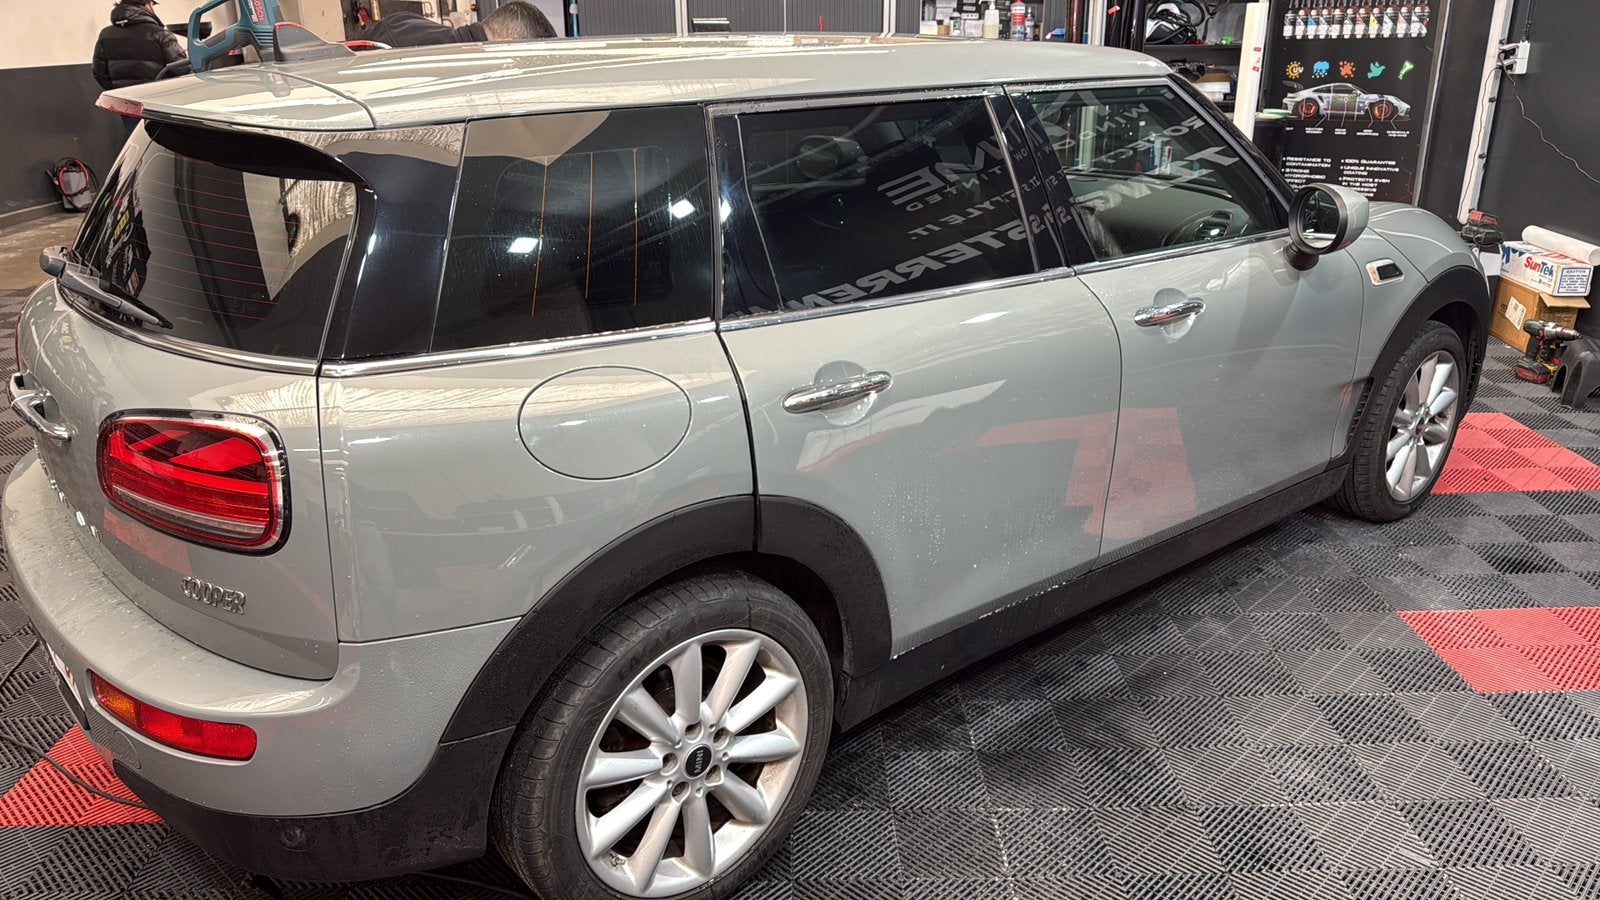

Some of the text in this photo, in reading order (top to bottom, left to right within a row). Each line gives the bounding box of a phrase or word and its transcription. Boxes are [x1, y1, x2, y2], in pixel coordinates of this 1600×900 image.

[253, 0, 265, 21] OSCH
[1292, 66, 1304, 74] UV
[1524, 256, 1555, 278] SunTek
[181, 576, 247, 615] COOPER
[694, 750, 704, 773] MINI
